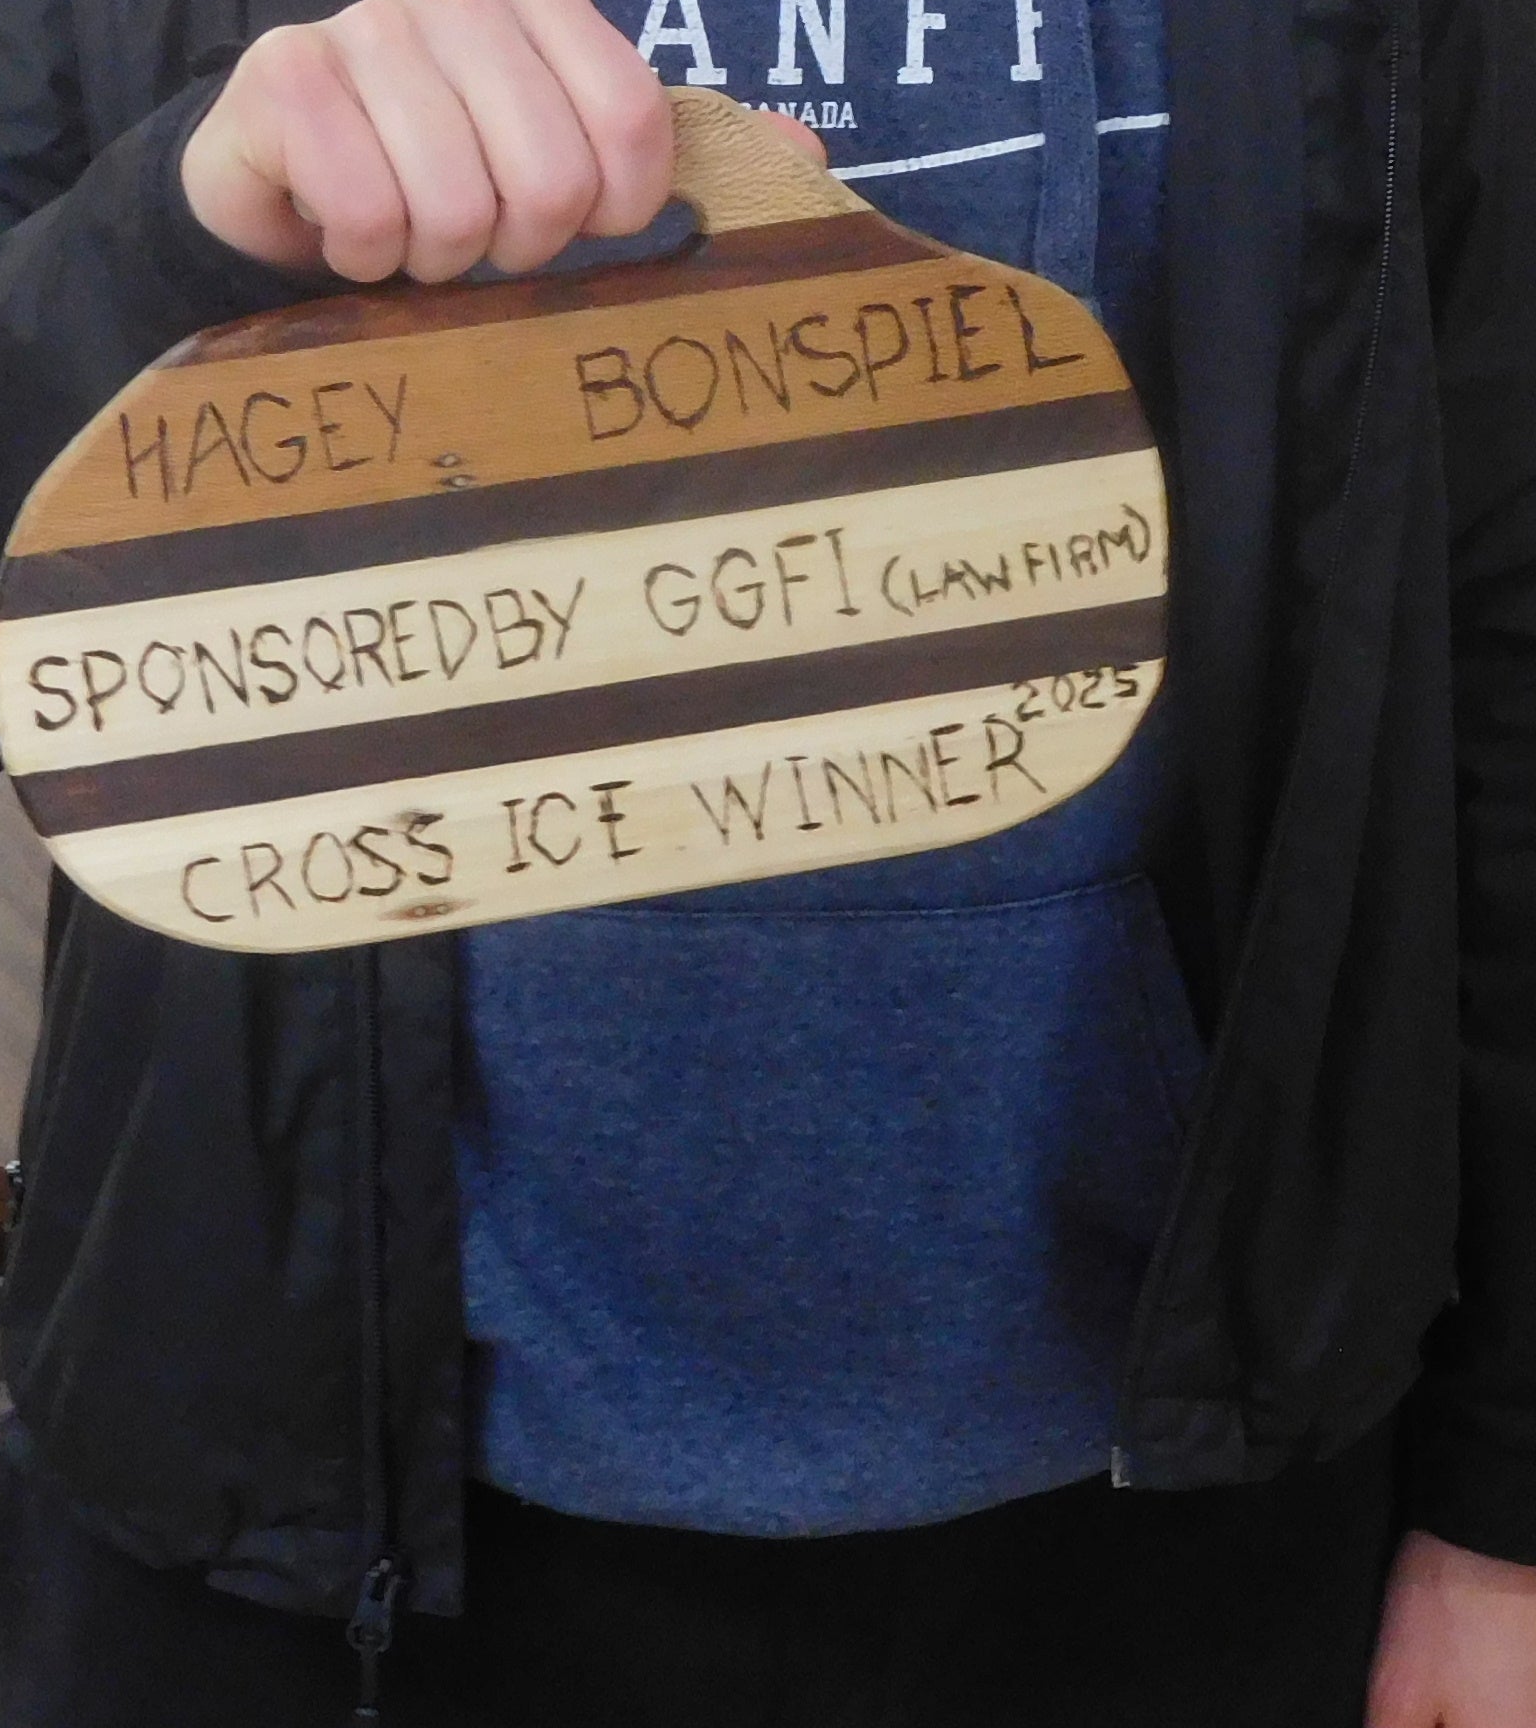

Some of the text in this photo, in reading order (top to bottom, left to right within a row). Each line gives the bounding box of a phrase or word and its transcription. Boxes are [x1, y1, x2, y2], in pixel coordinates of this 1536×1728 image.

[119, 284, 1085, 503] HAGEY BONSPIEL
[643, 527, 862, 637] GGFI
[181, 663, 1140, 923] CROSS ICE WINNER 2025
